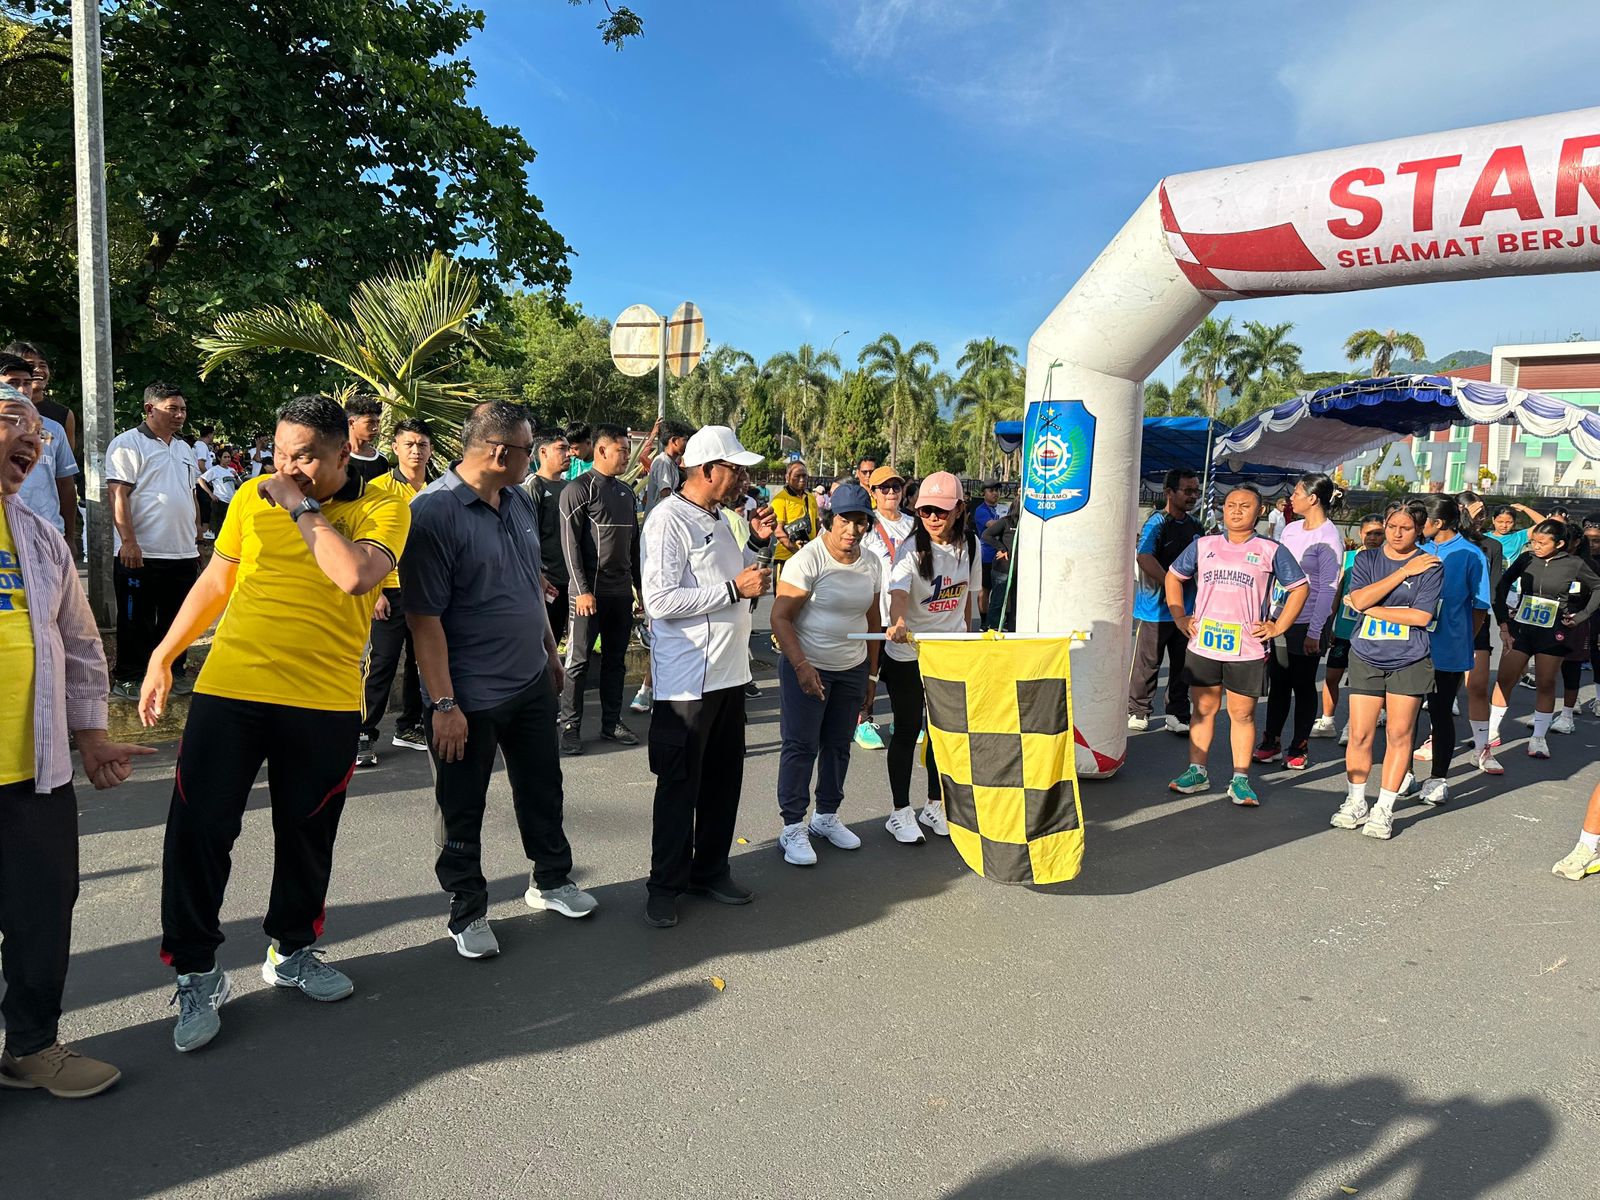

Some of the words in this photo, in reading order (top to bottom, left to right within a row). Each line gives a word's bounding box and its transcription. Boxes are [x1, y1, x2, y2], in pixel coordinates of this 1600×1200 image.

[1336, 236, 1485, 269] SELAMAT
[1037, 500, 1057, 510] 2003
[1213, 569, 1254, 588] HALMAHERA
[1521, 606, 1551, 625] 019
[1367, 618, 1402, 637] 014
[1203, 630, 1235, 651] 013
